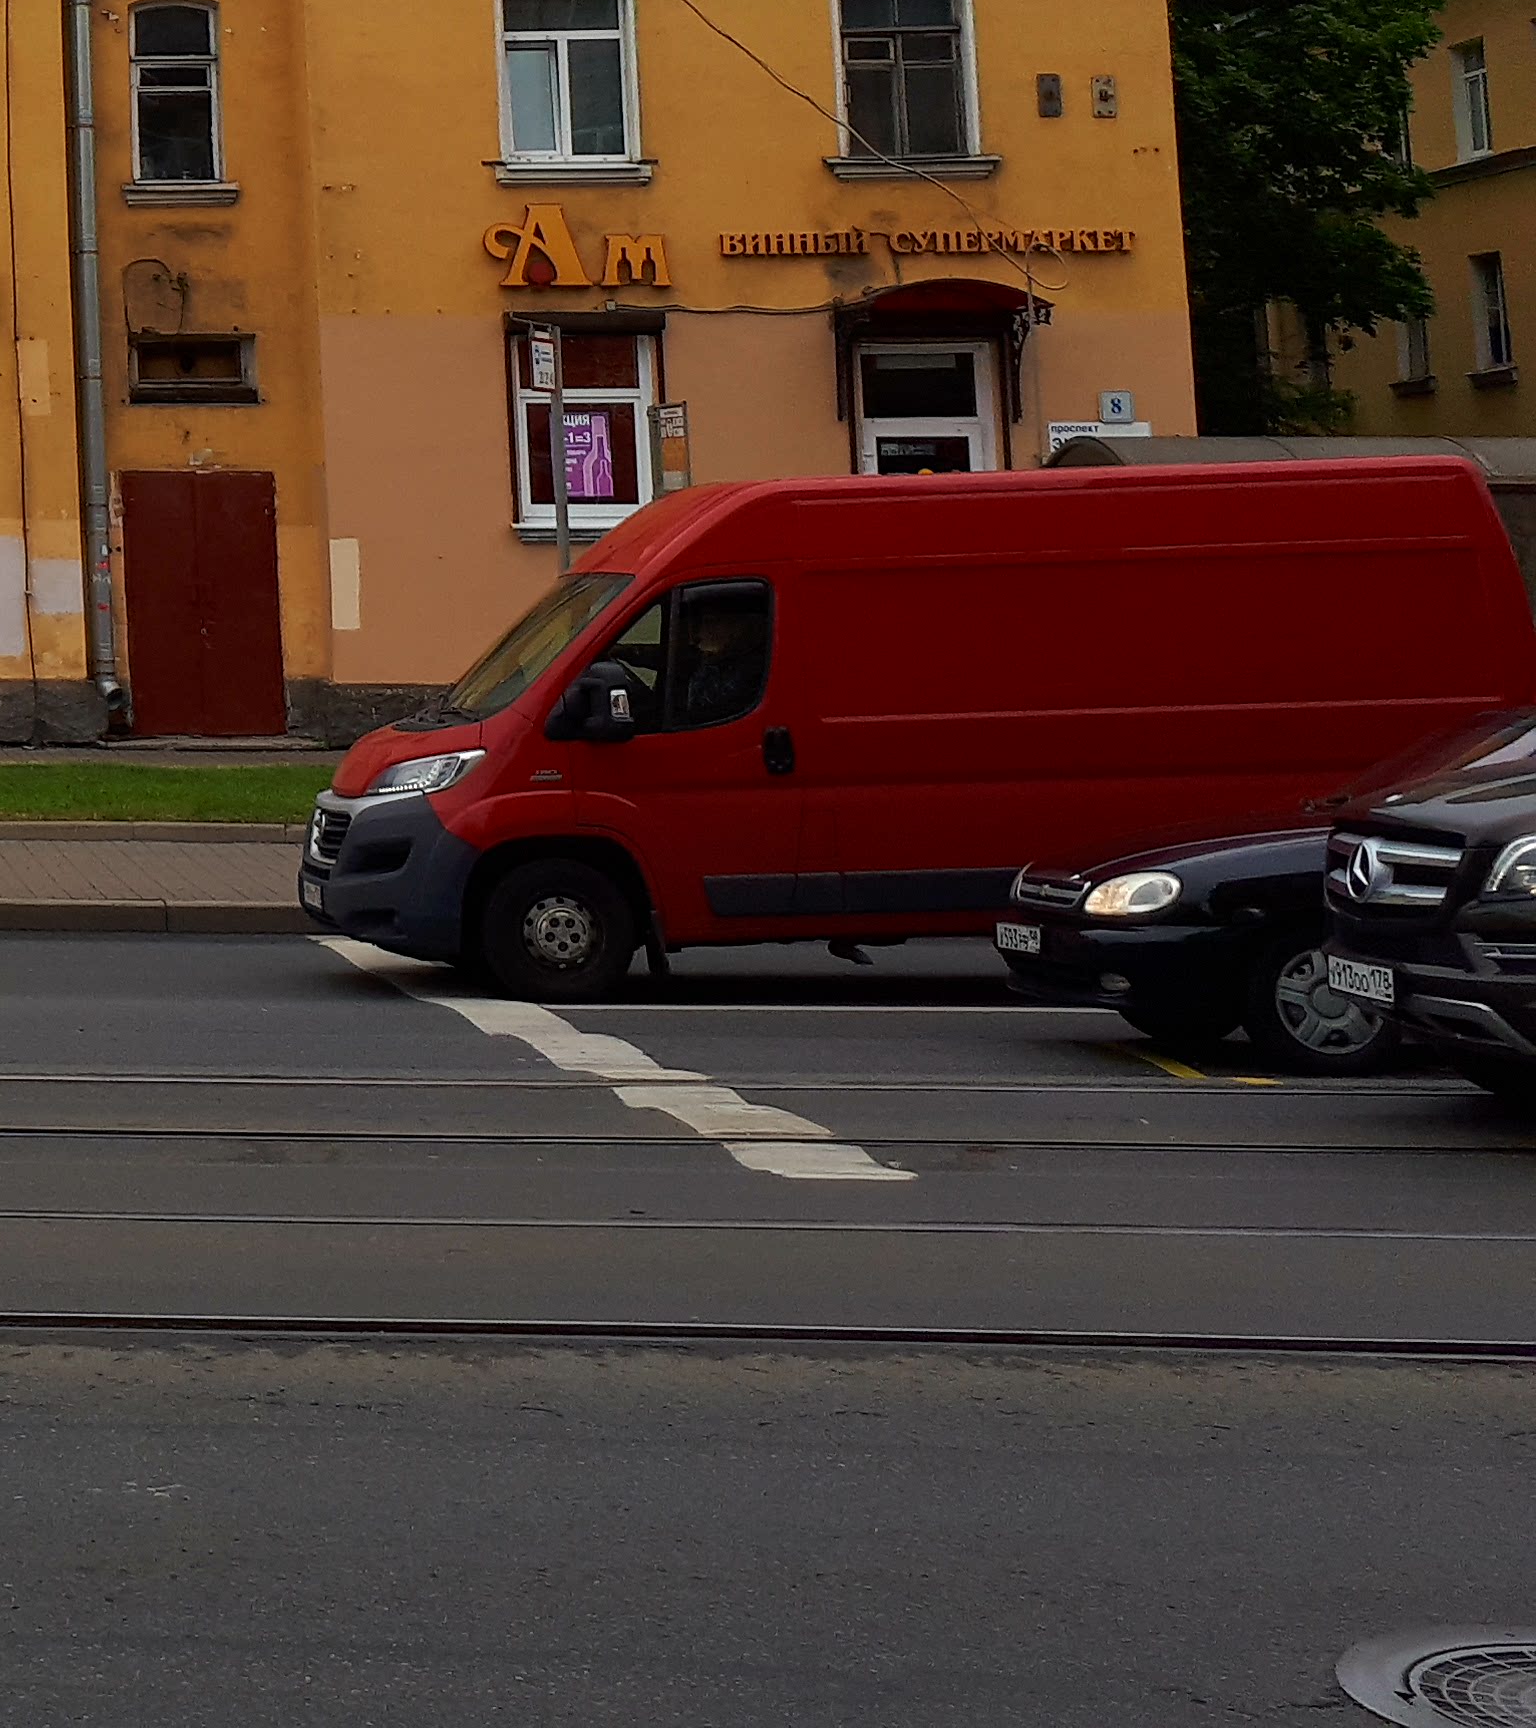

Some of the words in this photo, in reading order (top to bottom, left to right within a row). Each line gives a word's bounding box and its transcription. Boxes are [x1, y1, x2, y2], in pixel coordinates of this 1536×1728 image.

[719, 229, 871, 257] ВИННЫЙ
[889, 228, 1135, 255] СУПЕРМАРКЕТ
[1110, 397, 1122, 414] 8
[1051, 425, 1099, 434] проспект
